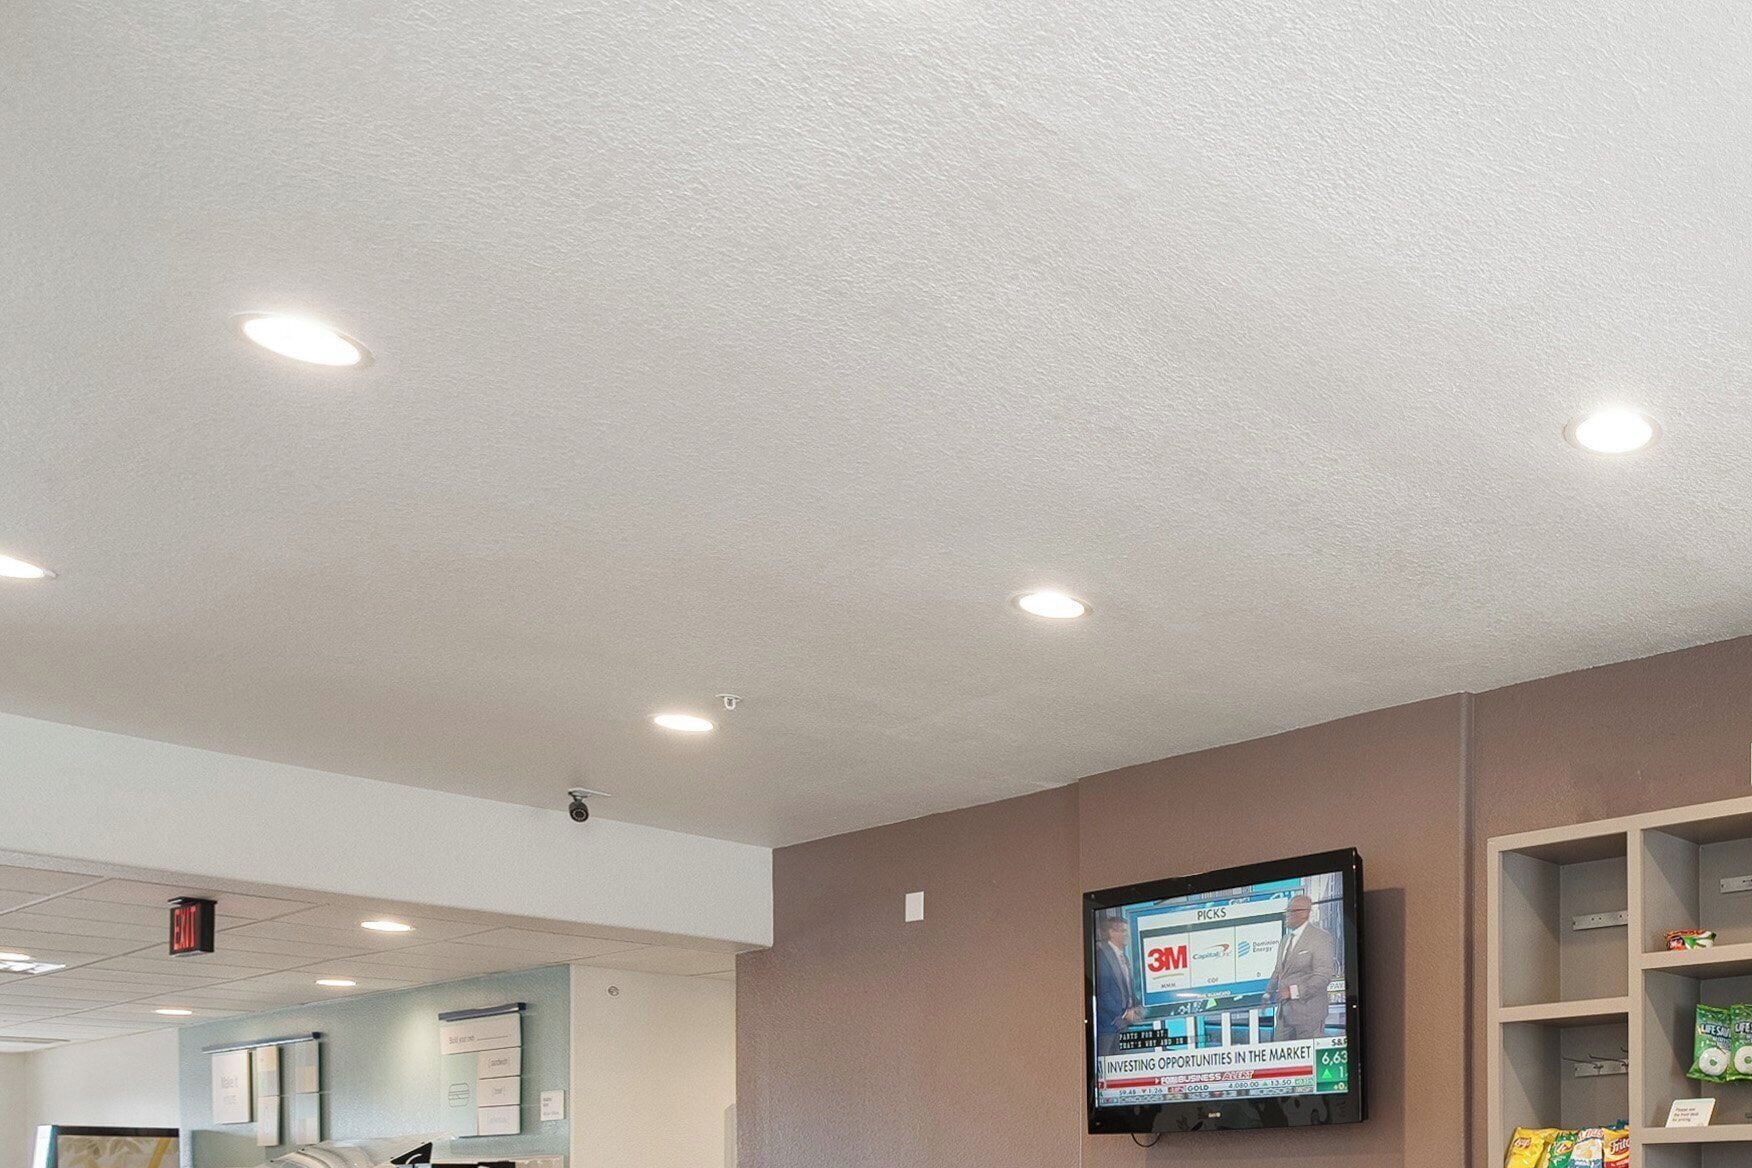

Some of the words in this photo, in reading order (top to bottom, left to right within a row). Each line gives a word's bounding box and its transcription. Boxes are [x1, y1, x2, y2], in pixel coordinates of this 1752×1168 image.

[1197, 907, 1227, 920] PICKS
[174, 905, 196, 950] EXIT
[1147, 944, 1188, 972] 3M
[1107, 1058, 1156, 1074] INVESTING
[1158, 1052, 1233, 1070] OPPORTUNITIES
[1235, 1051, 1247, 1064] IN
[1248, 1048, 1267, 1063] THE
[1269, 1046, 1312, 1061] MARKET
[1178, 1073, 1221, 1083] BUSINESS
[1187, 1084, 1210, 1092] GOLD
